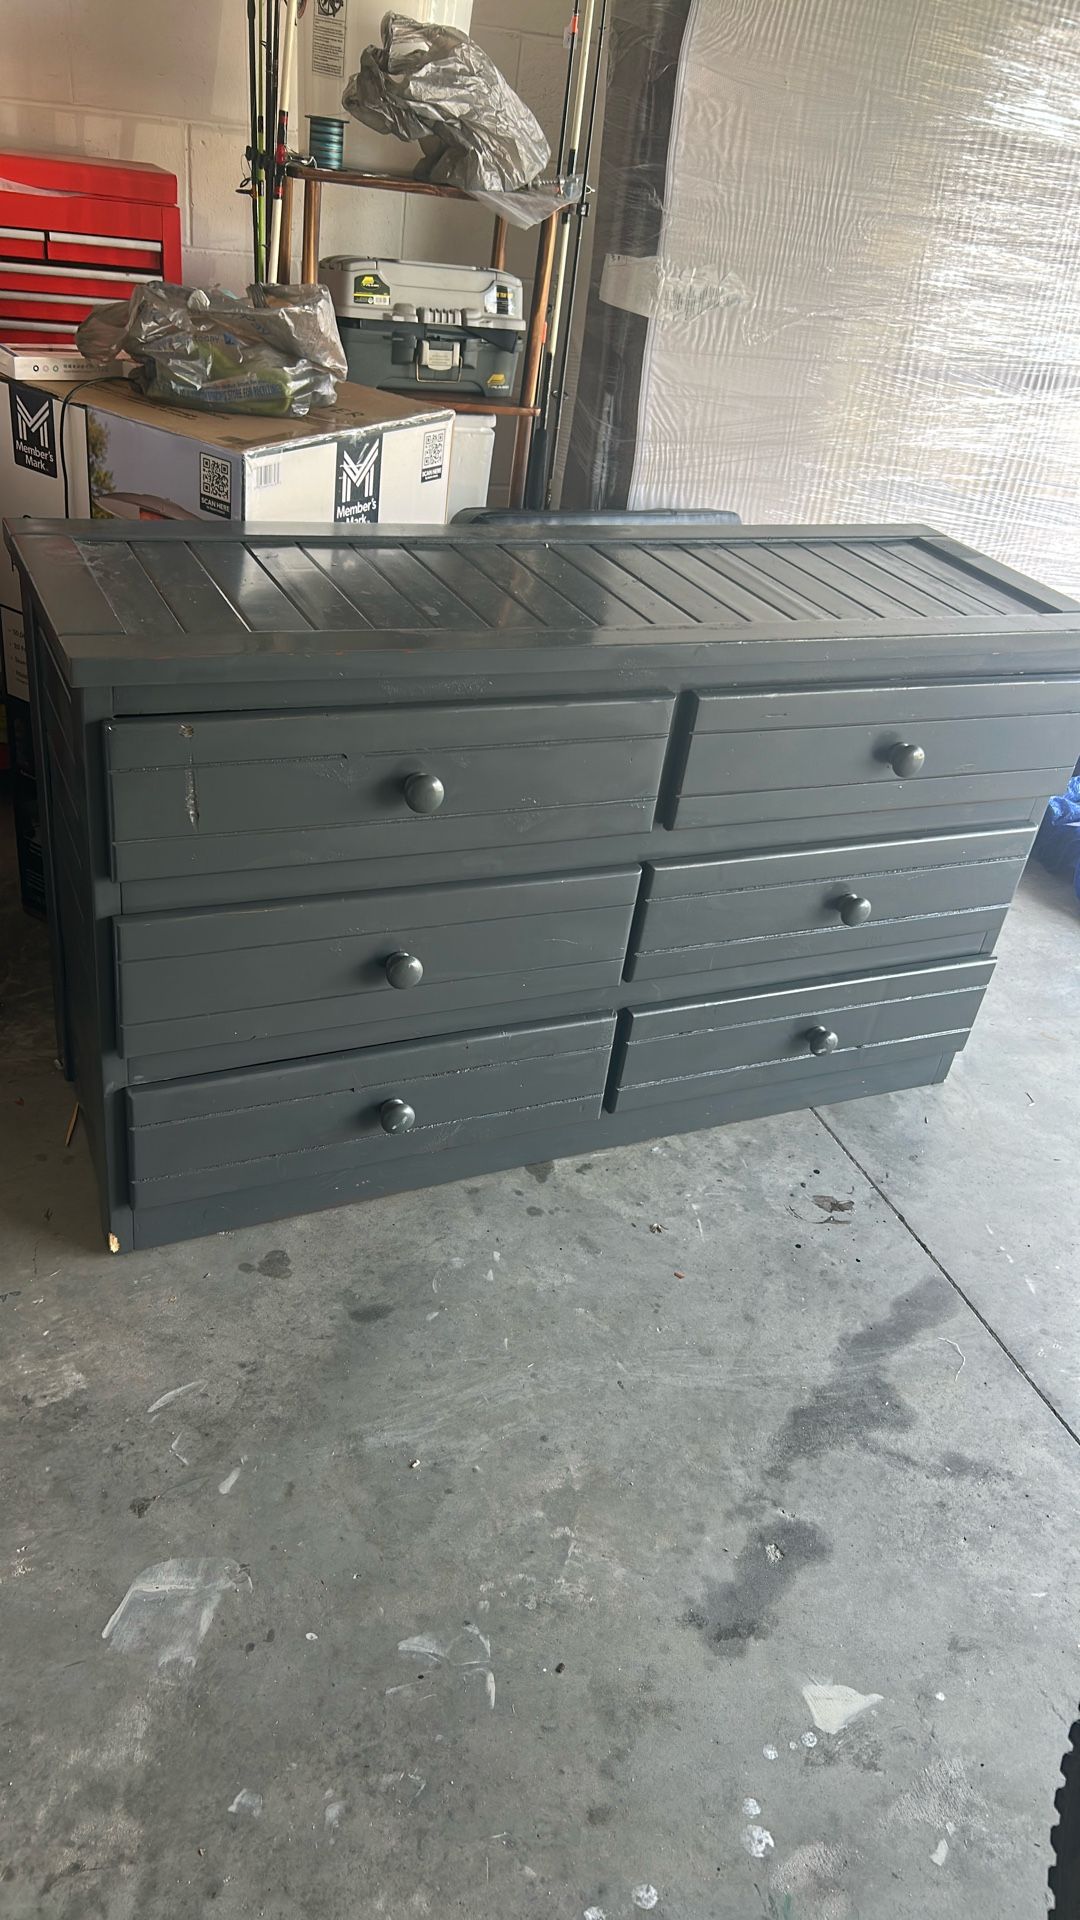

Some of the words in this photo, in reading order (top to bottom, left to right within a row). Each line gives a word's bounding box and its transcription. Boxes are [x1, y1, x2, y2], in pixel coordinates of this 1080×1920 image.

[15, 440, 54, 462] Member's
[25, 454, 46, 471] Mark
[336, 498, 377, 519] Member's
